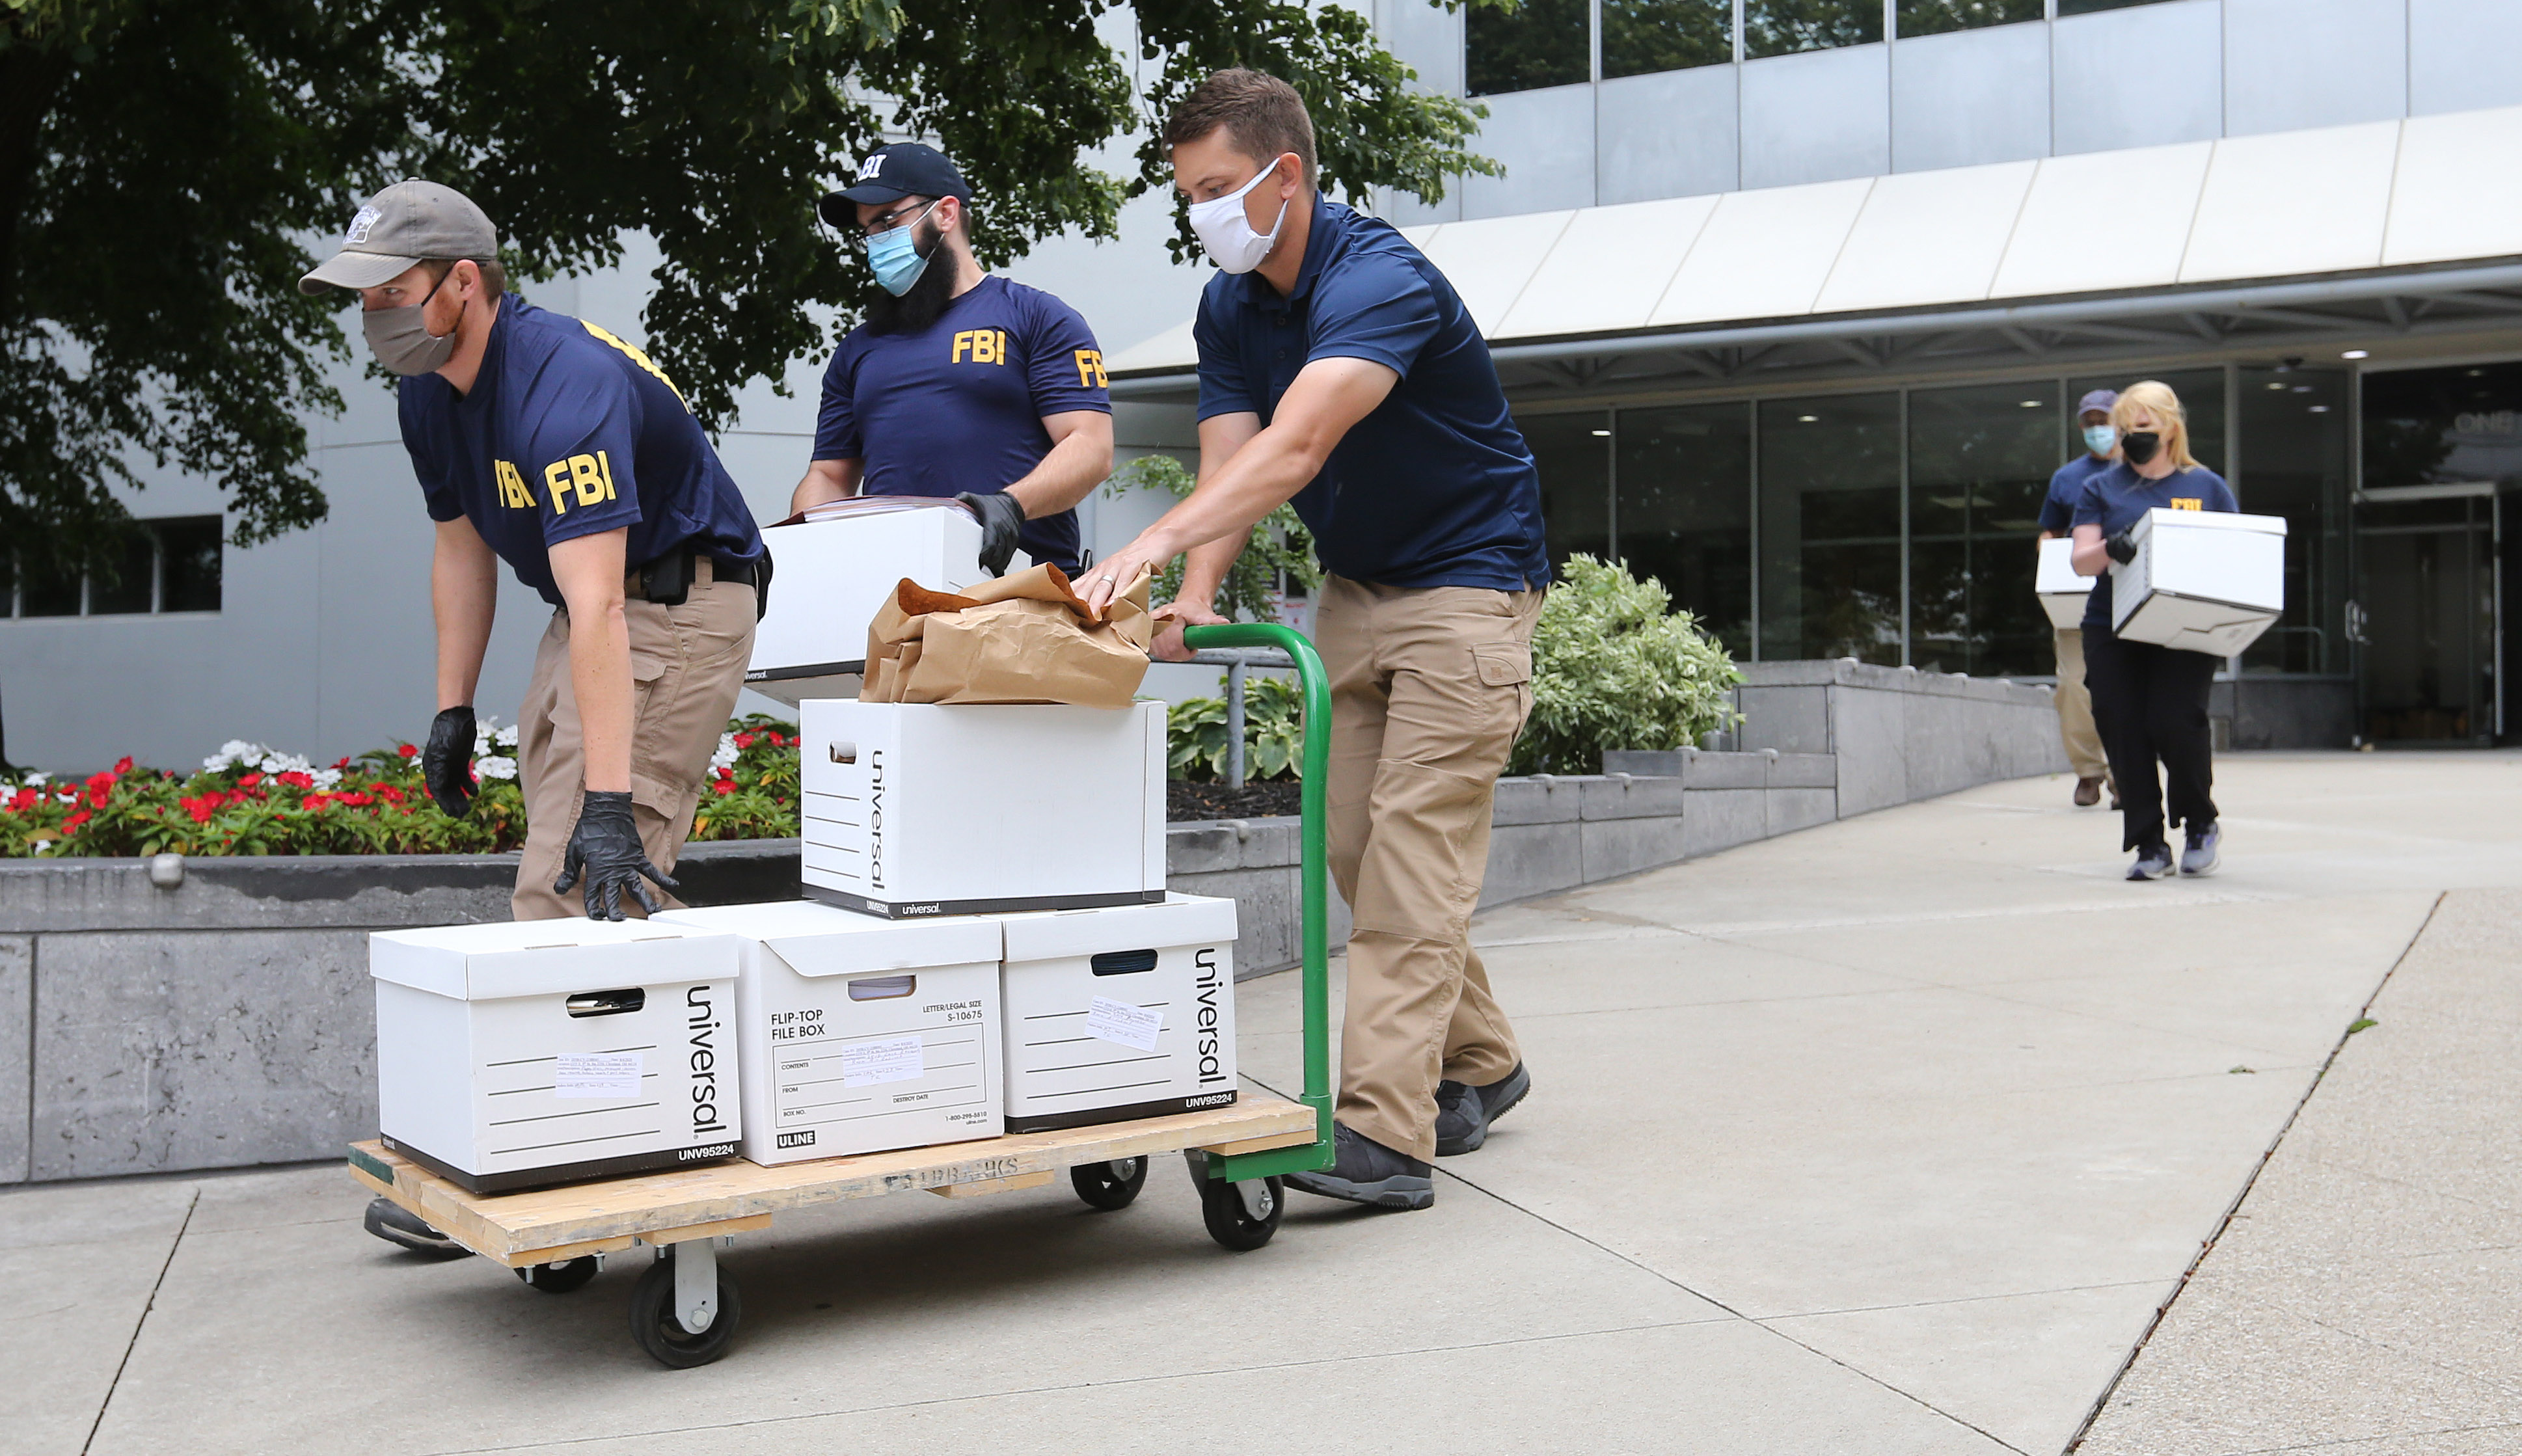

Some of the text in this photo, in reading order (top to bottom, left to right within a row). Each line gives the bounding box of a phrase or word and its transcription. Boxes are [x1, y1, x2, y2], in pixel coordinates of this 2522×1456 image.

[858, 154, 887, 182] BI
[952, 329, 1005, 366] FBI
[1074, 349, 1108, 388] FB
[495, 459, 537, 508] FBI
[544, 450, 616, 515] FBI
[872, 750, 885, 889] universal
[902, 902, 939, 915] universal
[771, 1009, 823, 1025] FLIP-TOP
[923, 1002, 967, 1013] LETTER/LEGAL
[947, 1010, 983, 1021] S-10675
[1195, 948, 1227, 1083] universal
[772, 1023, 826, 1040] FILE BOX
[687, 985, 727, 1133] universal
[1186, 1094, 1232, 1108] UNV95224
[779, 1132, 814, 1147] ULINE
[679, 1144, 734, 1161] UNV95224
